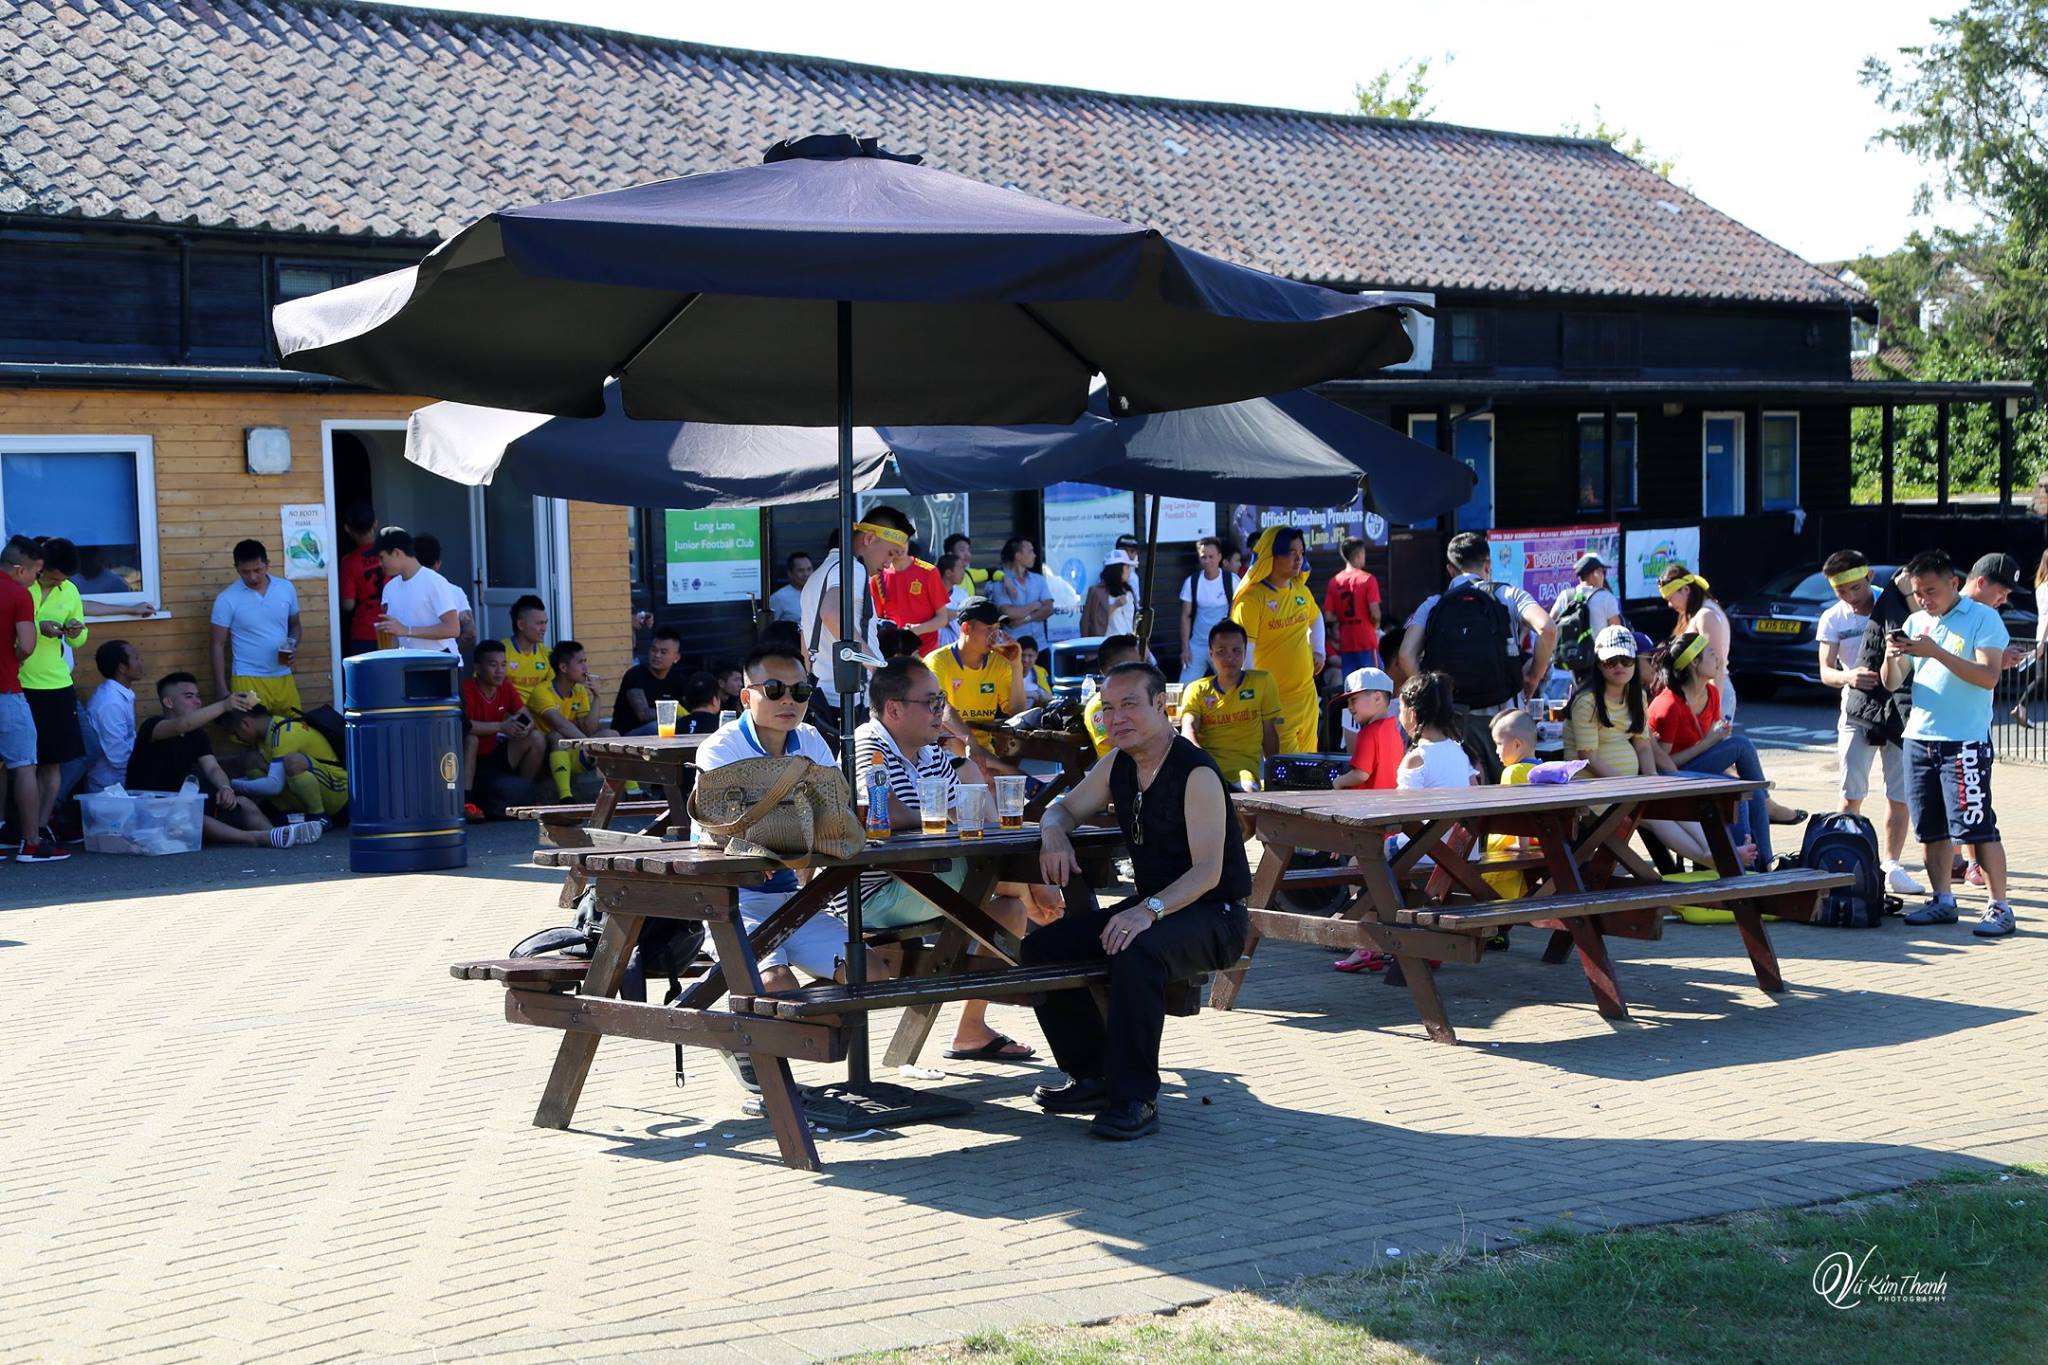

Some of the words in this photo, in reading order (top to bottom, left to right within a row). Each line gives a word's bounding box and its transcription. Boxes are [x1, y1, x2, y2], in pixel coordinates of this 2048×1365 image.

[1261, 510, 1290, 528] Official
[1291, 509, 1327, 528] Coaching
[1327, 507, 1363, 525] Providers
[694, 521, 714, 533] Long
[716, 520, 735, 531] Lane
[1311, 528, 1329, 545] Lane
[1330, 527, 1345, 544] JFC
[674, 540, 699, 552] Junior
[701, 538, 734, 550] Football
[736, 537, 754, 548] Club
[970, 709, 995, 717] BANK
[1961, 740, 1985, 825] Superdry
